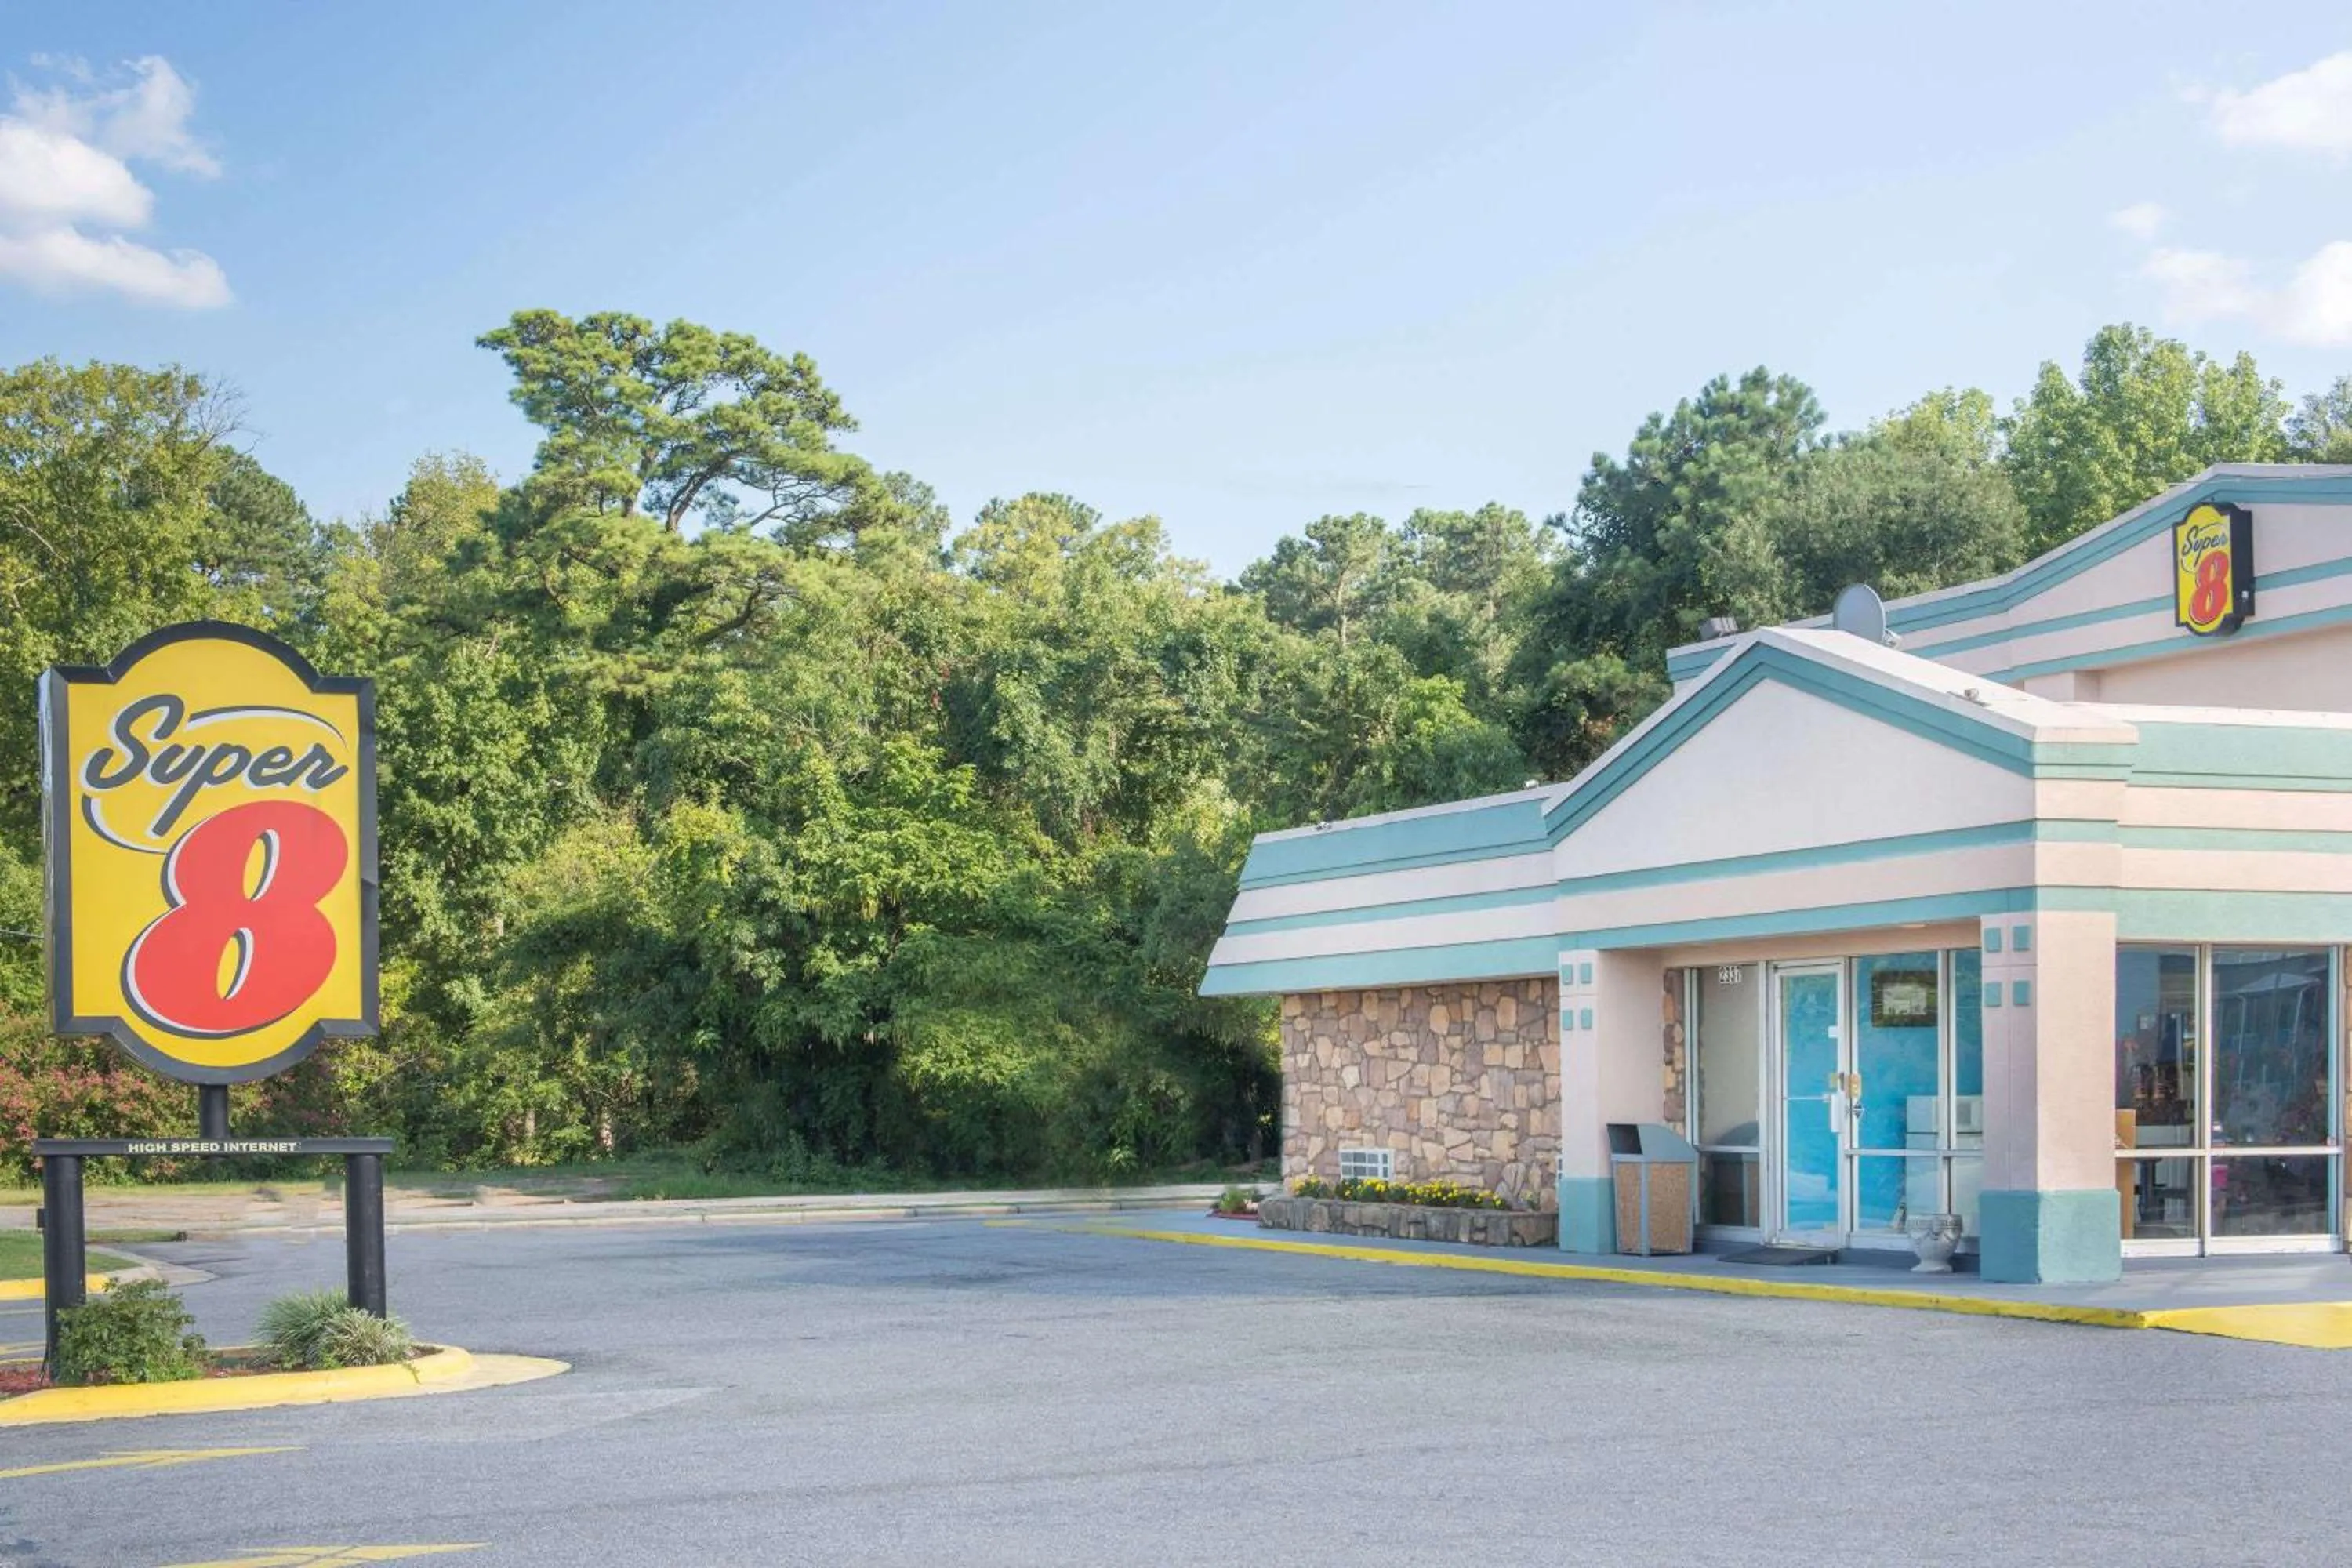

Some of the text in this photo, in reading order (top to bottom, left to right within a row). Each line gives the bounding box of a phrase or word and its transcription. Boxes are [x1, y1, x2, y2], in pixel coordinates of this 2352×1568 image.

[2182, 525, 2227, 568] Super
[2189, 551, 2229, 625] 8
[82, 693, 350, 838] Super
[121, 800, 350, 1039] 8
[128, 1142, 297, 1153] HIGH SPEED INTERNET
